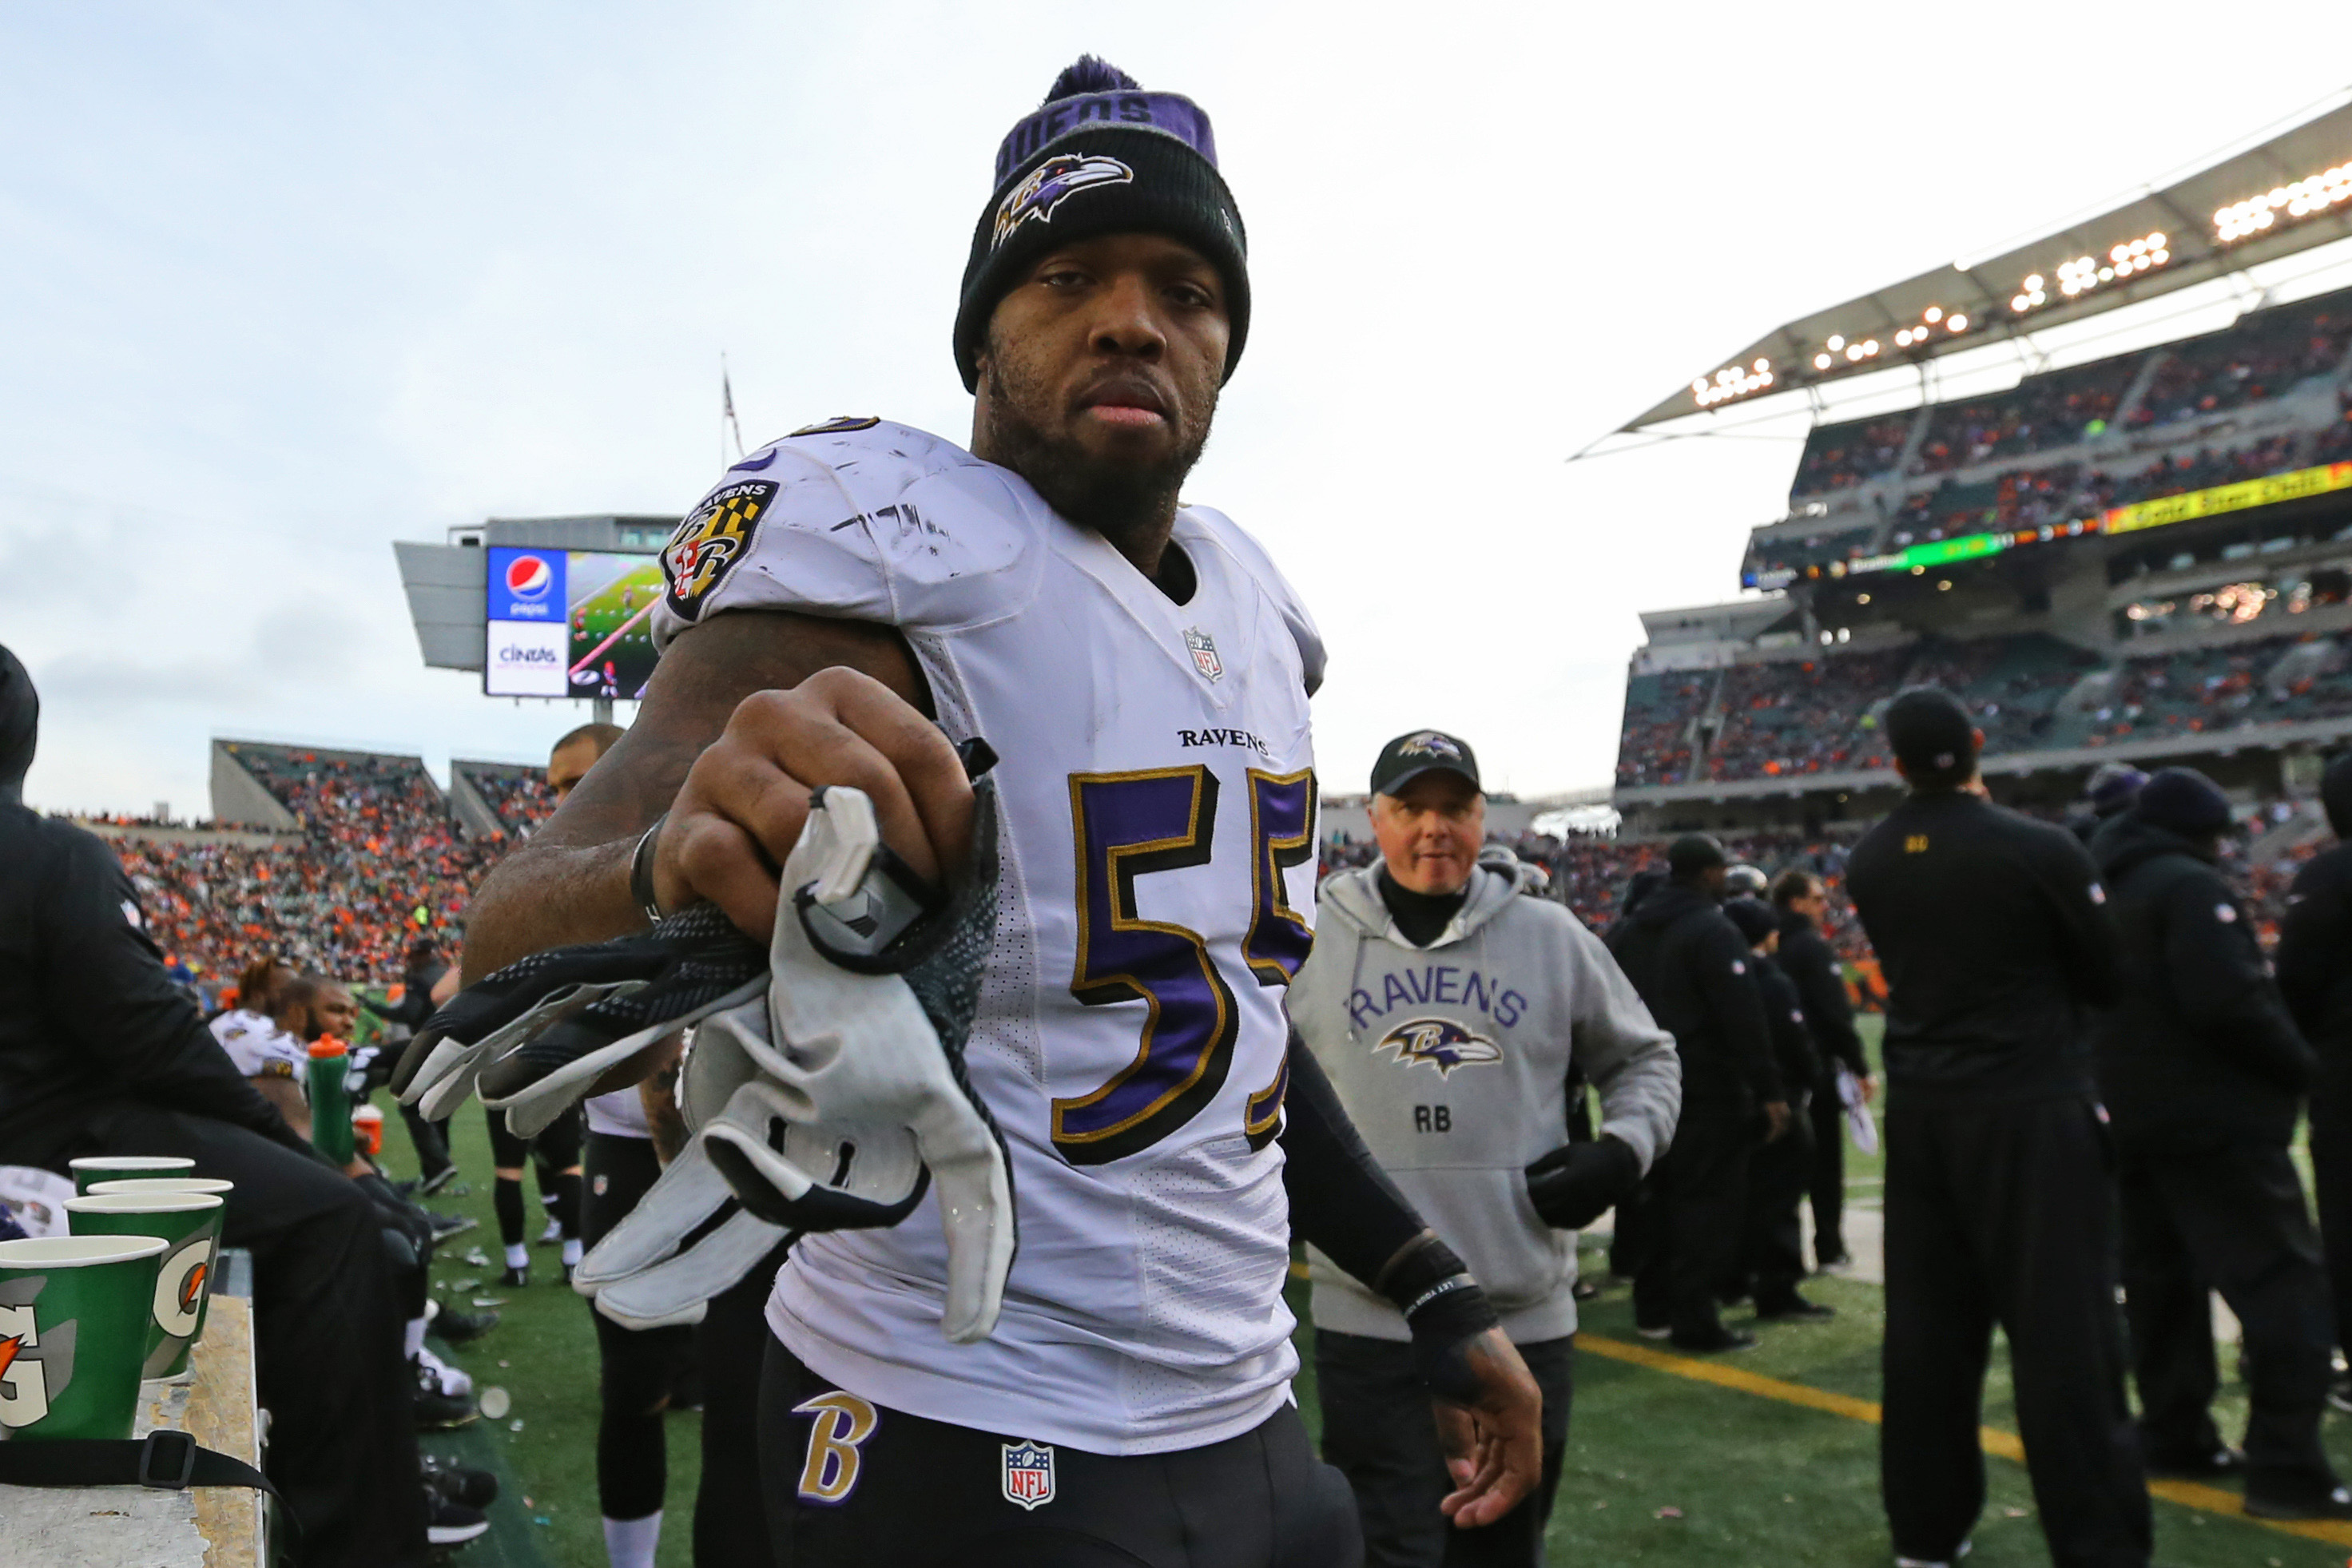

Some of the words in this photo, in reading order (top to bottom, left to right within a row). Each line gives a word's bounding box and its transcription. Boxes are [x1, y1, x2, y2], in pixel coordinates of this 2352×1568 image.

[1194, 650, 1220, 674] NFL
[1178, 728, 1269, 756] RAVENS
[1051, 764, 1320, 1165] 55
[1344, 966, 1528, 1030] RAVENS
[1414, 1105, 1451, 1133] RB
[791, 1390, 879, 1503] B
[1011, 1471, 1047, 1498] NFL
